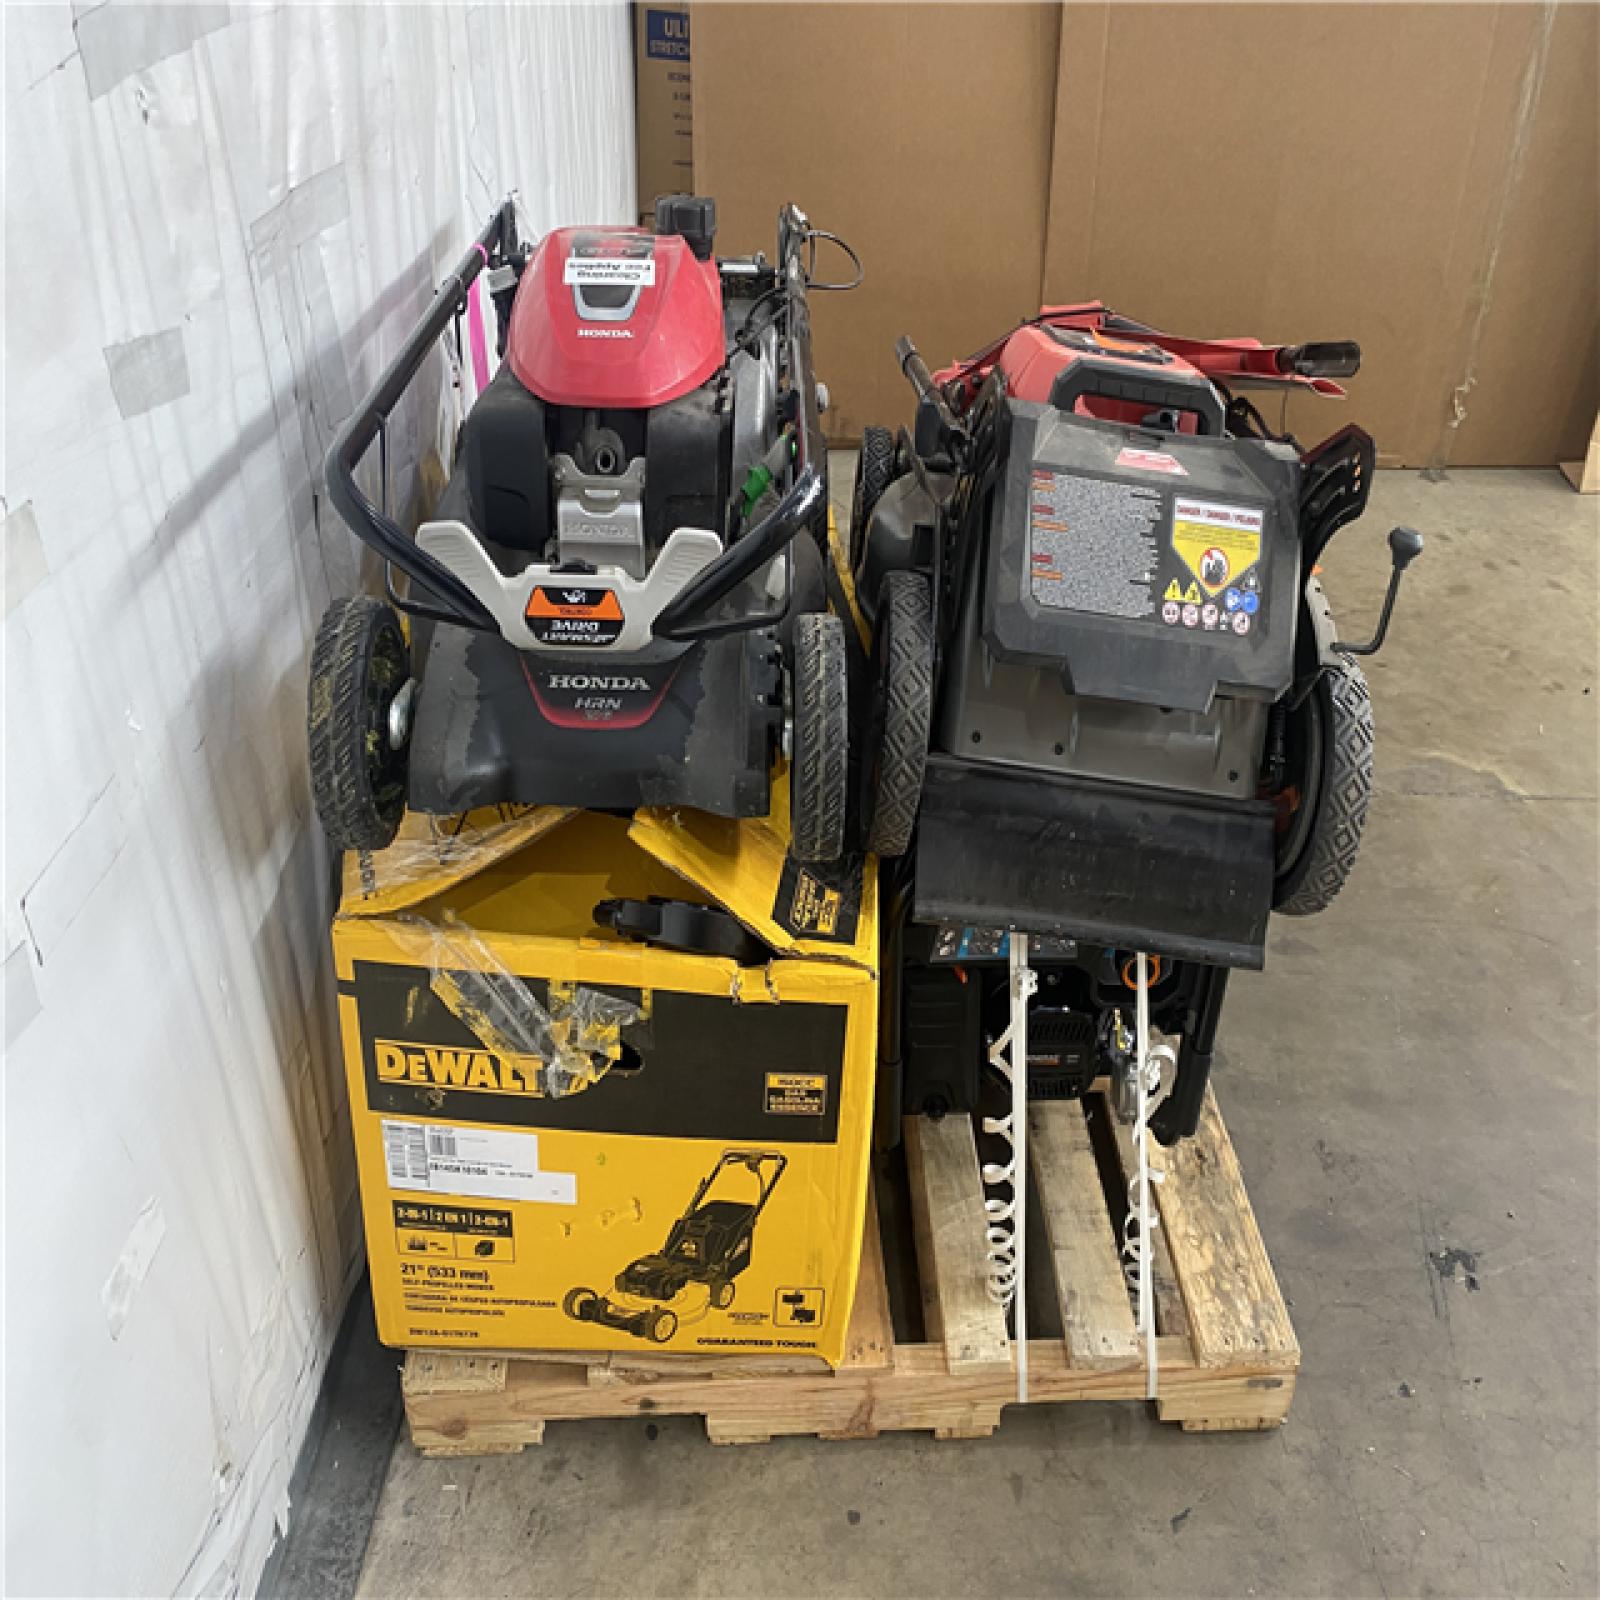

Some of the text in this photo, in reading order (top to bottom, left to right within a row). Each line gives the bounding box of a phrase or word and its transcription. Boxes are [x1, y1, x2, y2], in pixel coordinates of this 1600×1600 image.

[577, 329, 634, 338] HONDA
[549, 675, 650, 690] HONDA
[575, 697, 623, 711] HRN
[376, 1044, 544, 1093] DEWALT
